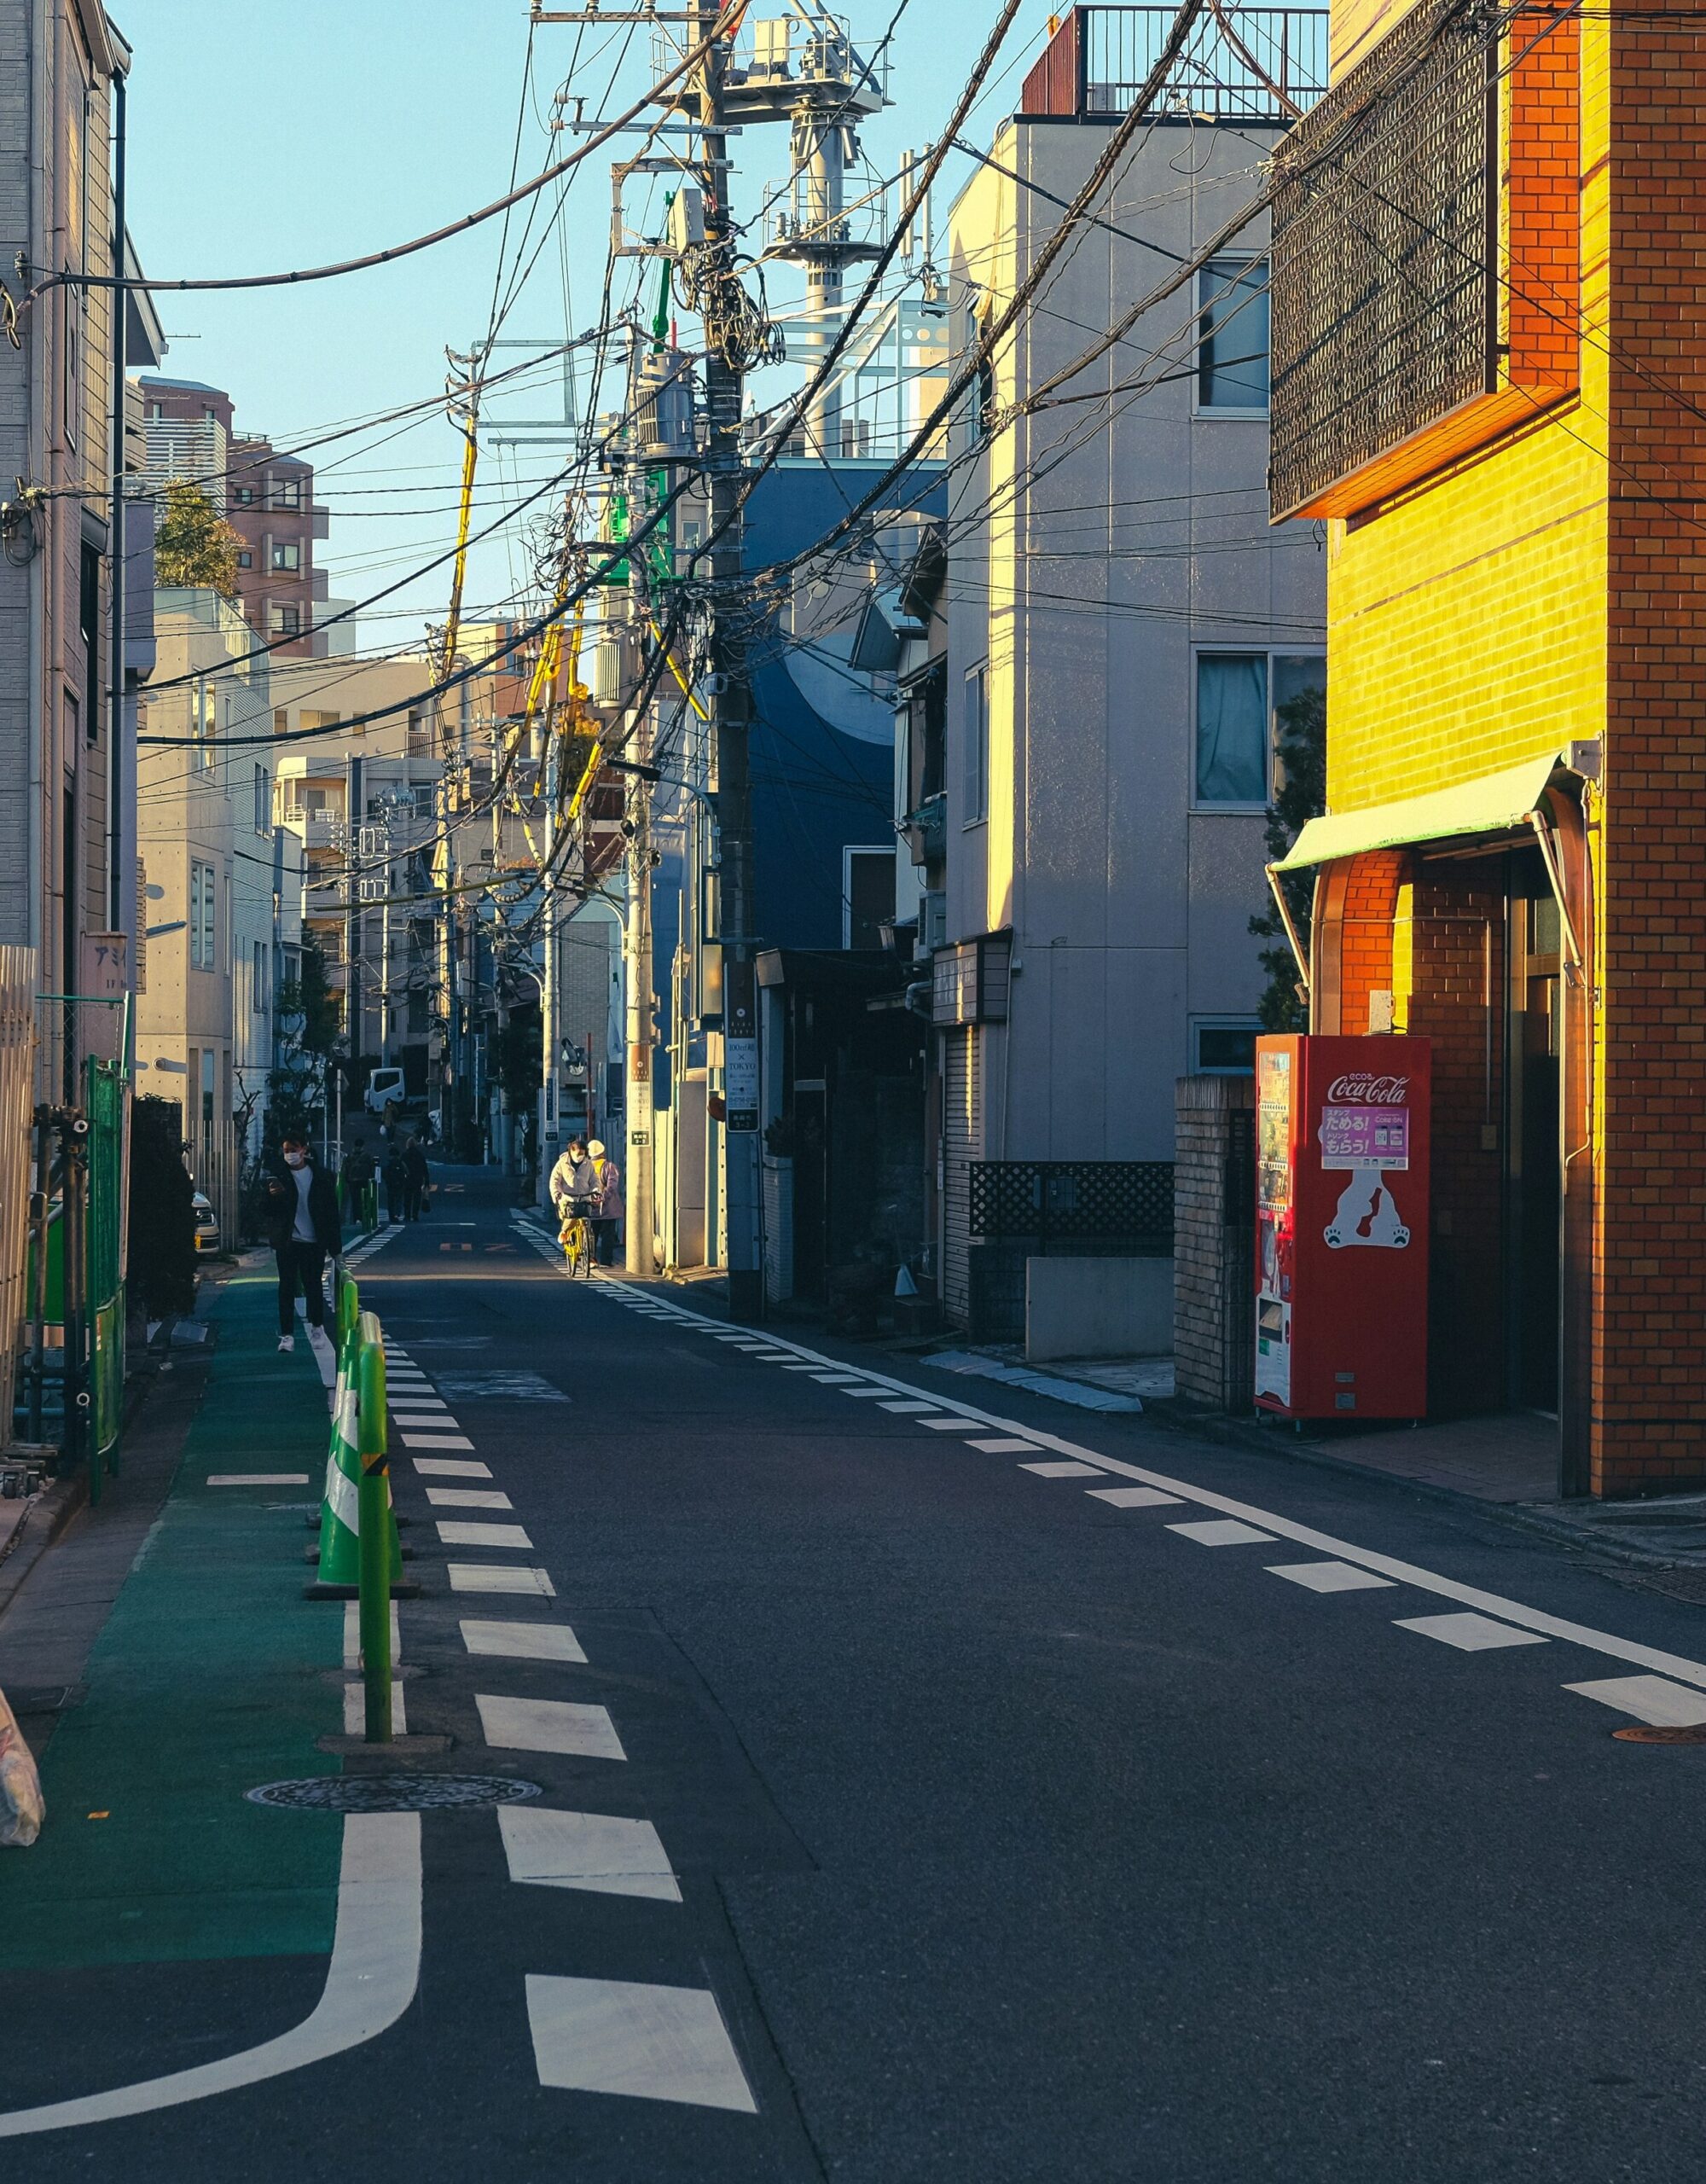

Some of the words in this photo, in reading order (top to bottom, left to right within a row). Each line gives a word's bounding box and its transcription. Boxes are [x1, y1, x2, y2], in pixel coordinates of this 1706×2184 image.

[1327, 1076, 1411, 1103] Coca-Cola
[1326, 1116, 1370, 1131] ためる!
[1326, 1139, 1370, 1154] もらう!
